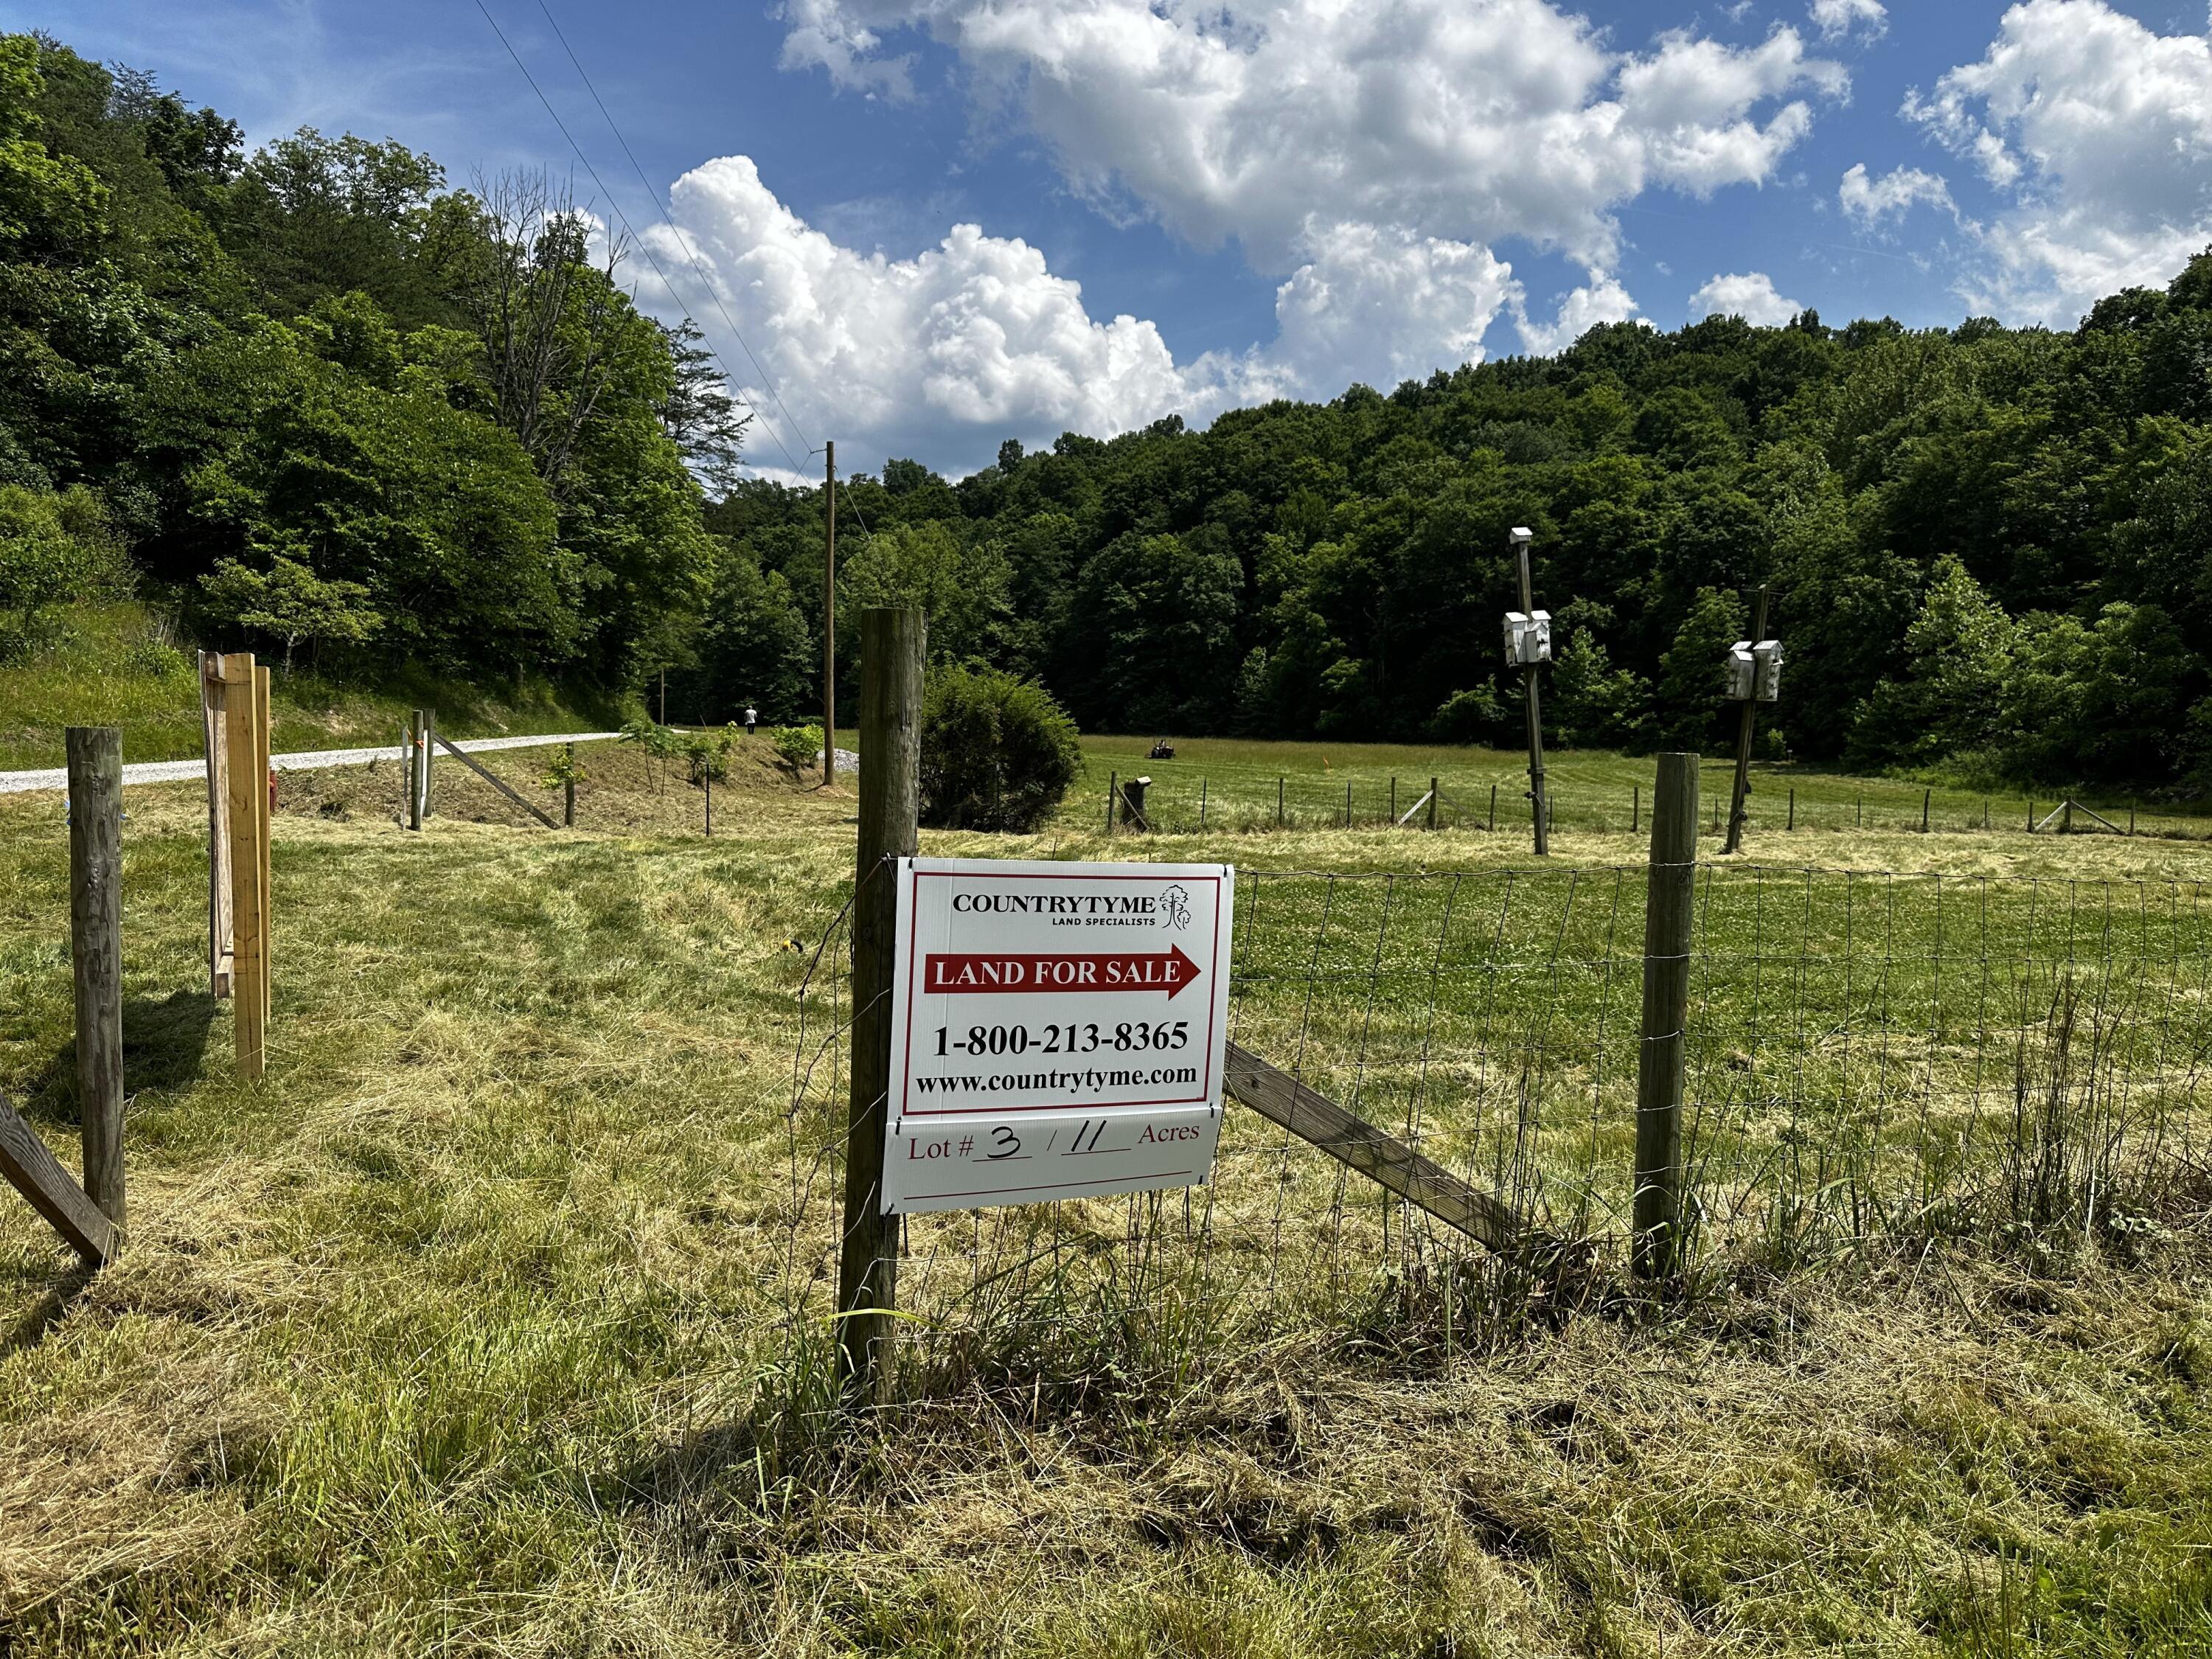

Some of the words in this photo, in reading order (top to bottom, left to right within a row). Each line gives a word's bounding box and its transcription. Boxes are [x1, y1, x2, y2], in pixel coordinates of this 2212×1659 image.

[953, 894, 1156, 914] COUNTRYTYME
[1085, 918, 1155, 926] SPECIALISTS
[933, 961, 1024, 985] LAND
[1034, 961, 1097, 984] FOR
[1106, 960, 1180, 983] SALE
[933, 1021, 1189, 1056] 1-800-213-8365
[916, 1068, 1197, 1093] www.countrytyme.com
[908, 1138, 951, 1160] Lot
[987, 1126, 1020, 1159] 3
[1071, 1120, 1107, 1152] 11
[1138, 1124, 1200, 1144] Acres
